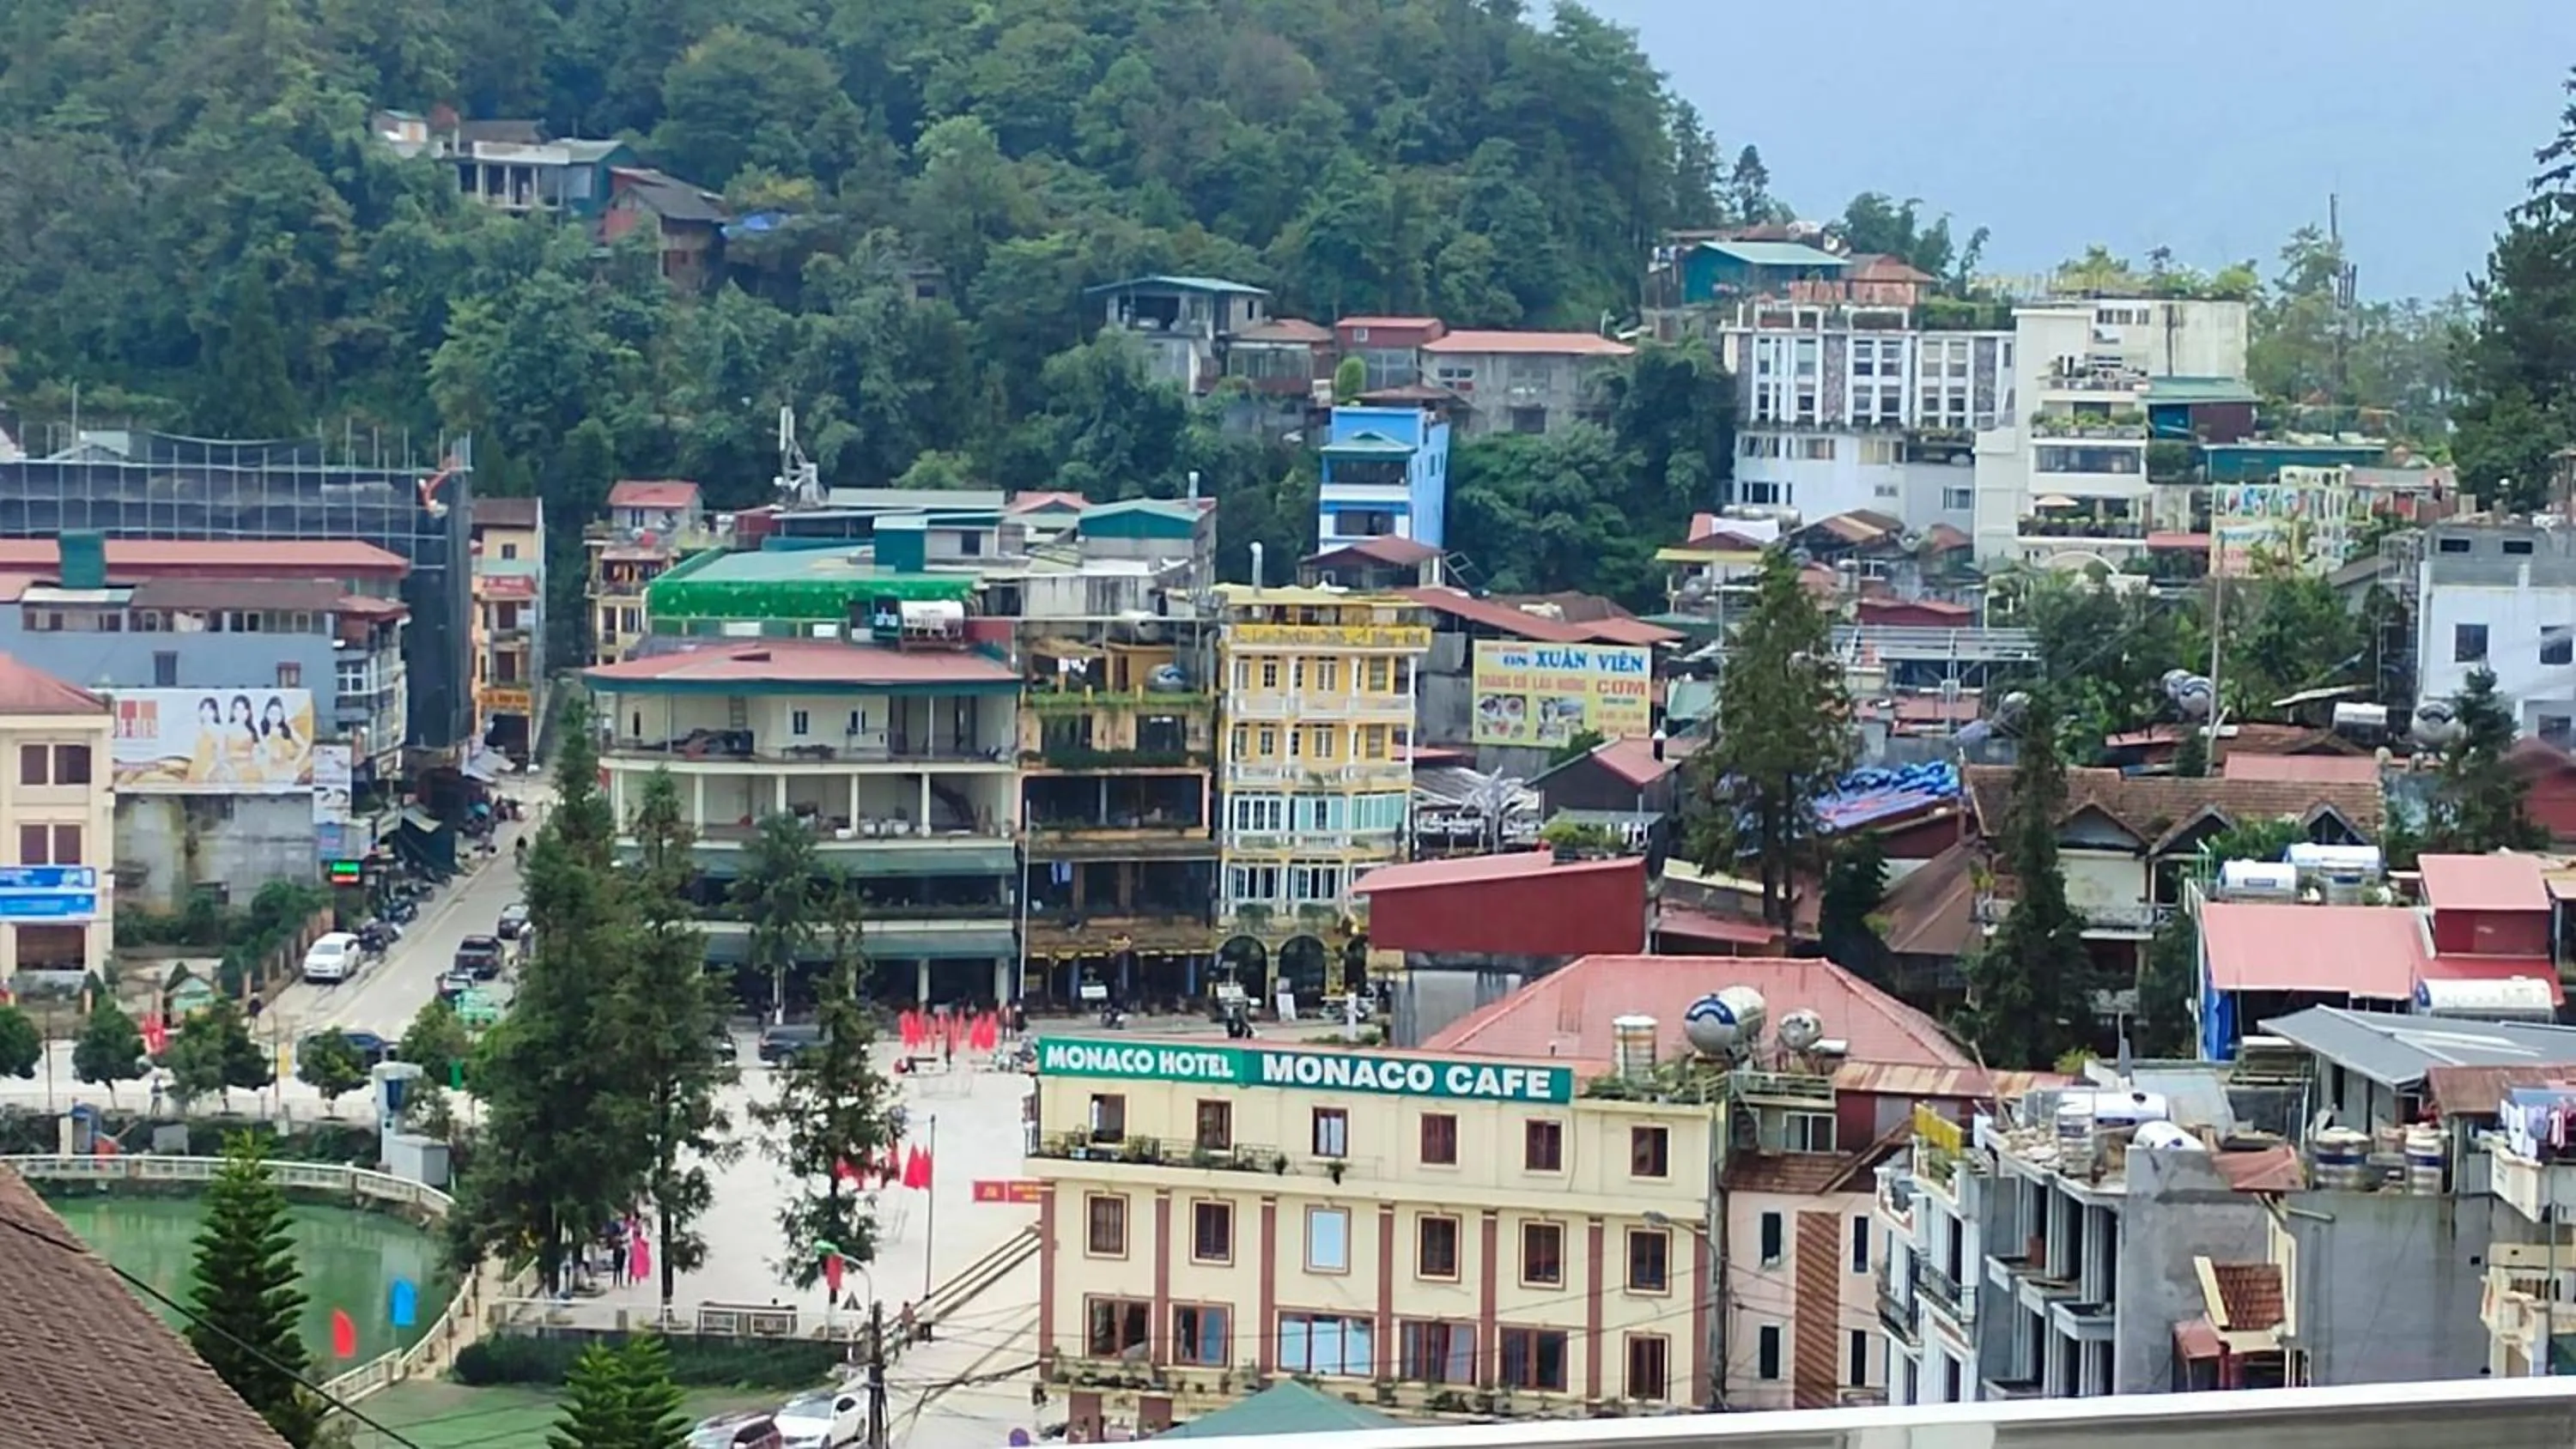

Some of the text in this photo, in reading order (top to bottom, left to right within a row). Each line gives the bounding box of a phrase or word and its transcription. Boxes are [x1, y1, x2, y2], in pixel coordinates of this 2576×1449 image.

[1045, 1045, 1235, 1078] MONACO HOTEL
[1262, 1053, 1552, 1099] MONACO CAFE
